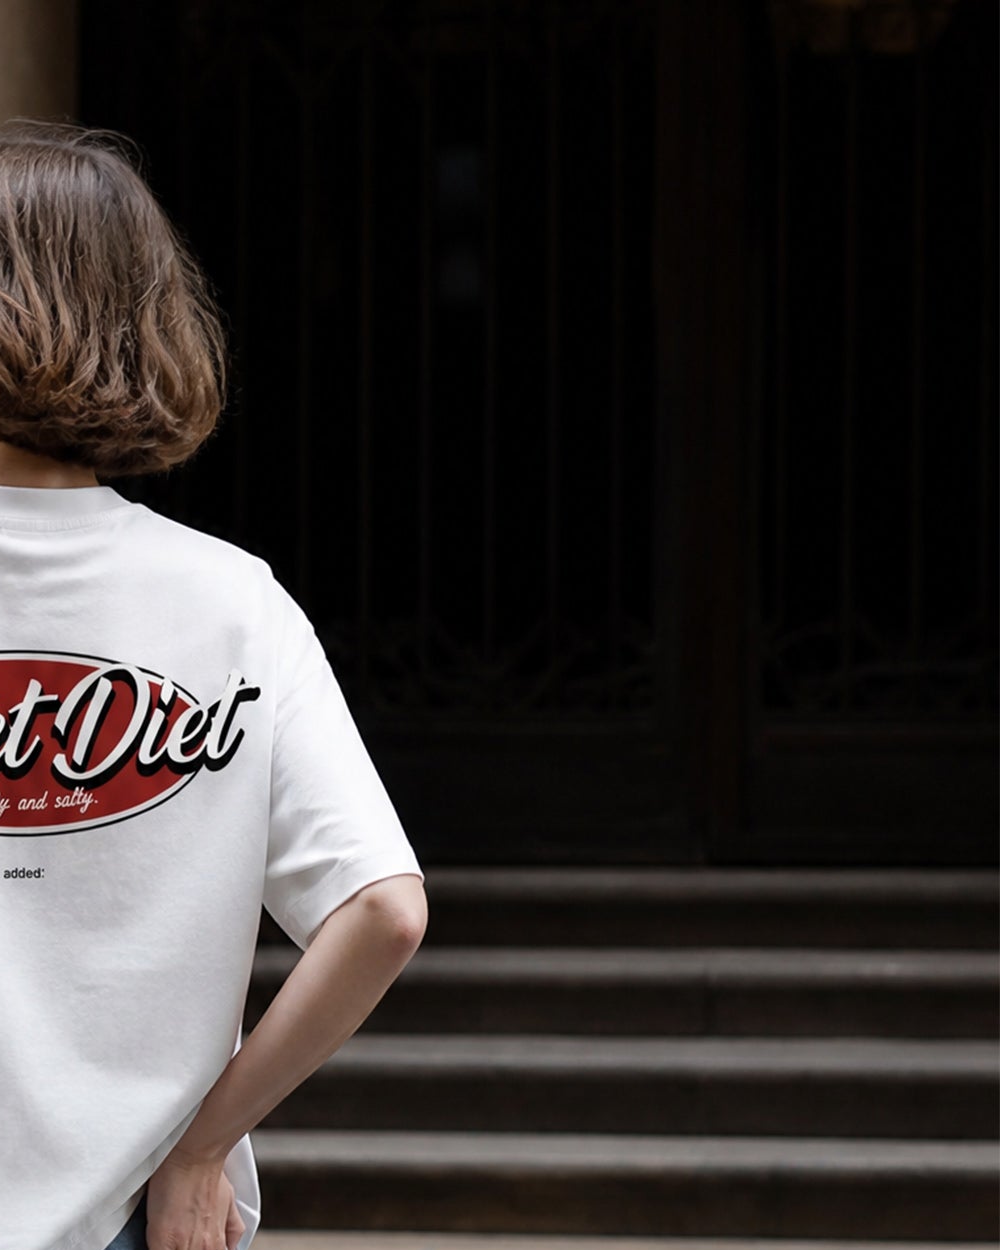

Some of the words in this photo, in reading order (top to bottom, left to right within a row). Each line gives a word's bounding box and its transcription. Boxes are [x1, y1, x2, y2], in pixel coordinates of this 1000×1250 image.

[51, 663, 261, 790] Diet
[18, 790, 49, 811] and
[54, 786, 99, 814] salty.
[3, 867, 45, 879] added:
